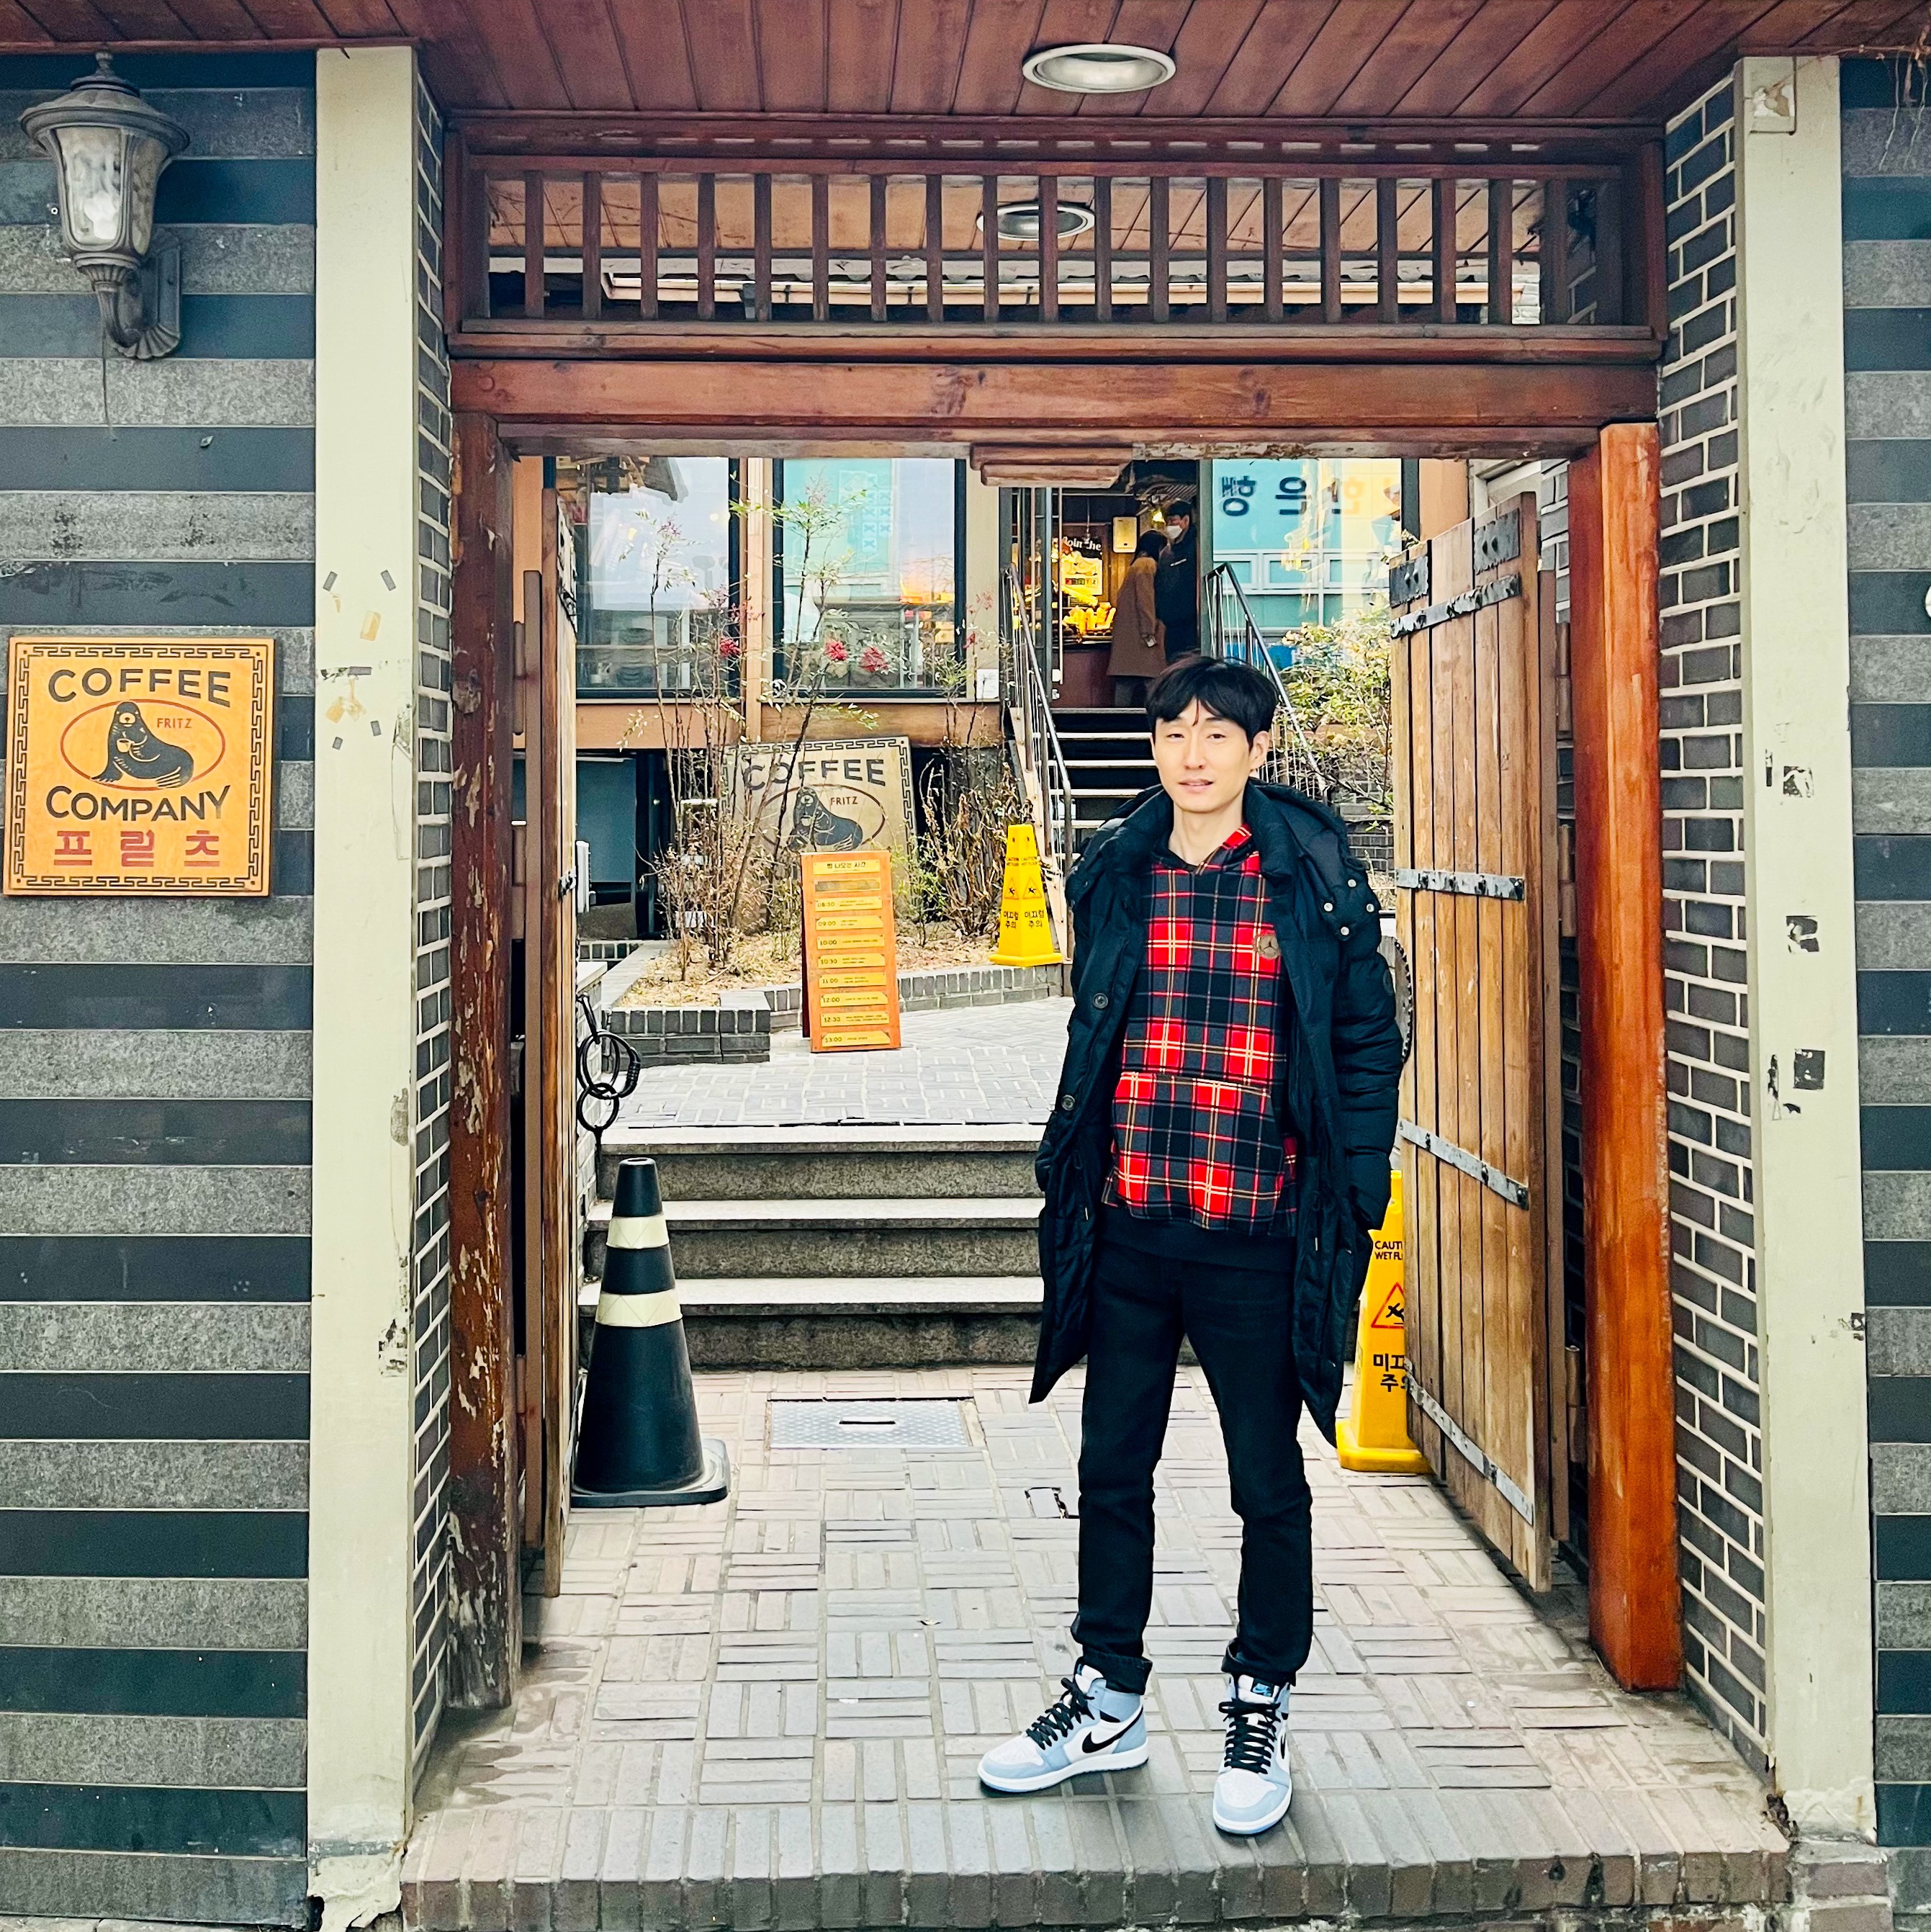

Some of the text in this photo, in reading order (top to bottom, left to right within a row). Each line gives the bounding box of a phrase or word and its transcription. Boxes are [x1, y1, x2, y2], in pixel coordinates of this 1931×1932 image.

[48, 668, 231, 708] COFFEE
[157, 717, 192, 729] FRITZ
[743, 759, 886, 791] COFFEE
[46, 785, 230, 822] COMPANY
[830, 796, 858, 806] FRITZ
[54, 830, 220, 867] 프릳츠
[1029, 920, 1042, 929] 주의
[1374, 1251, 1403, 1261] WET FL
